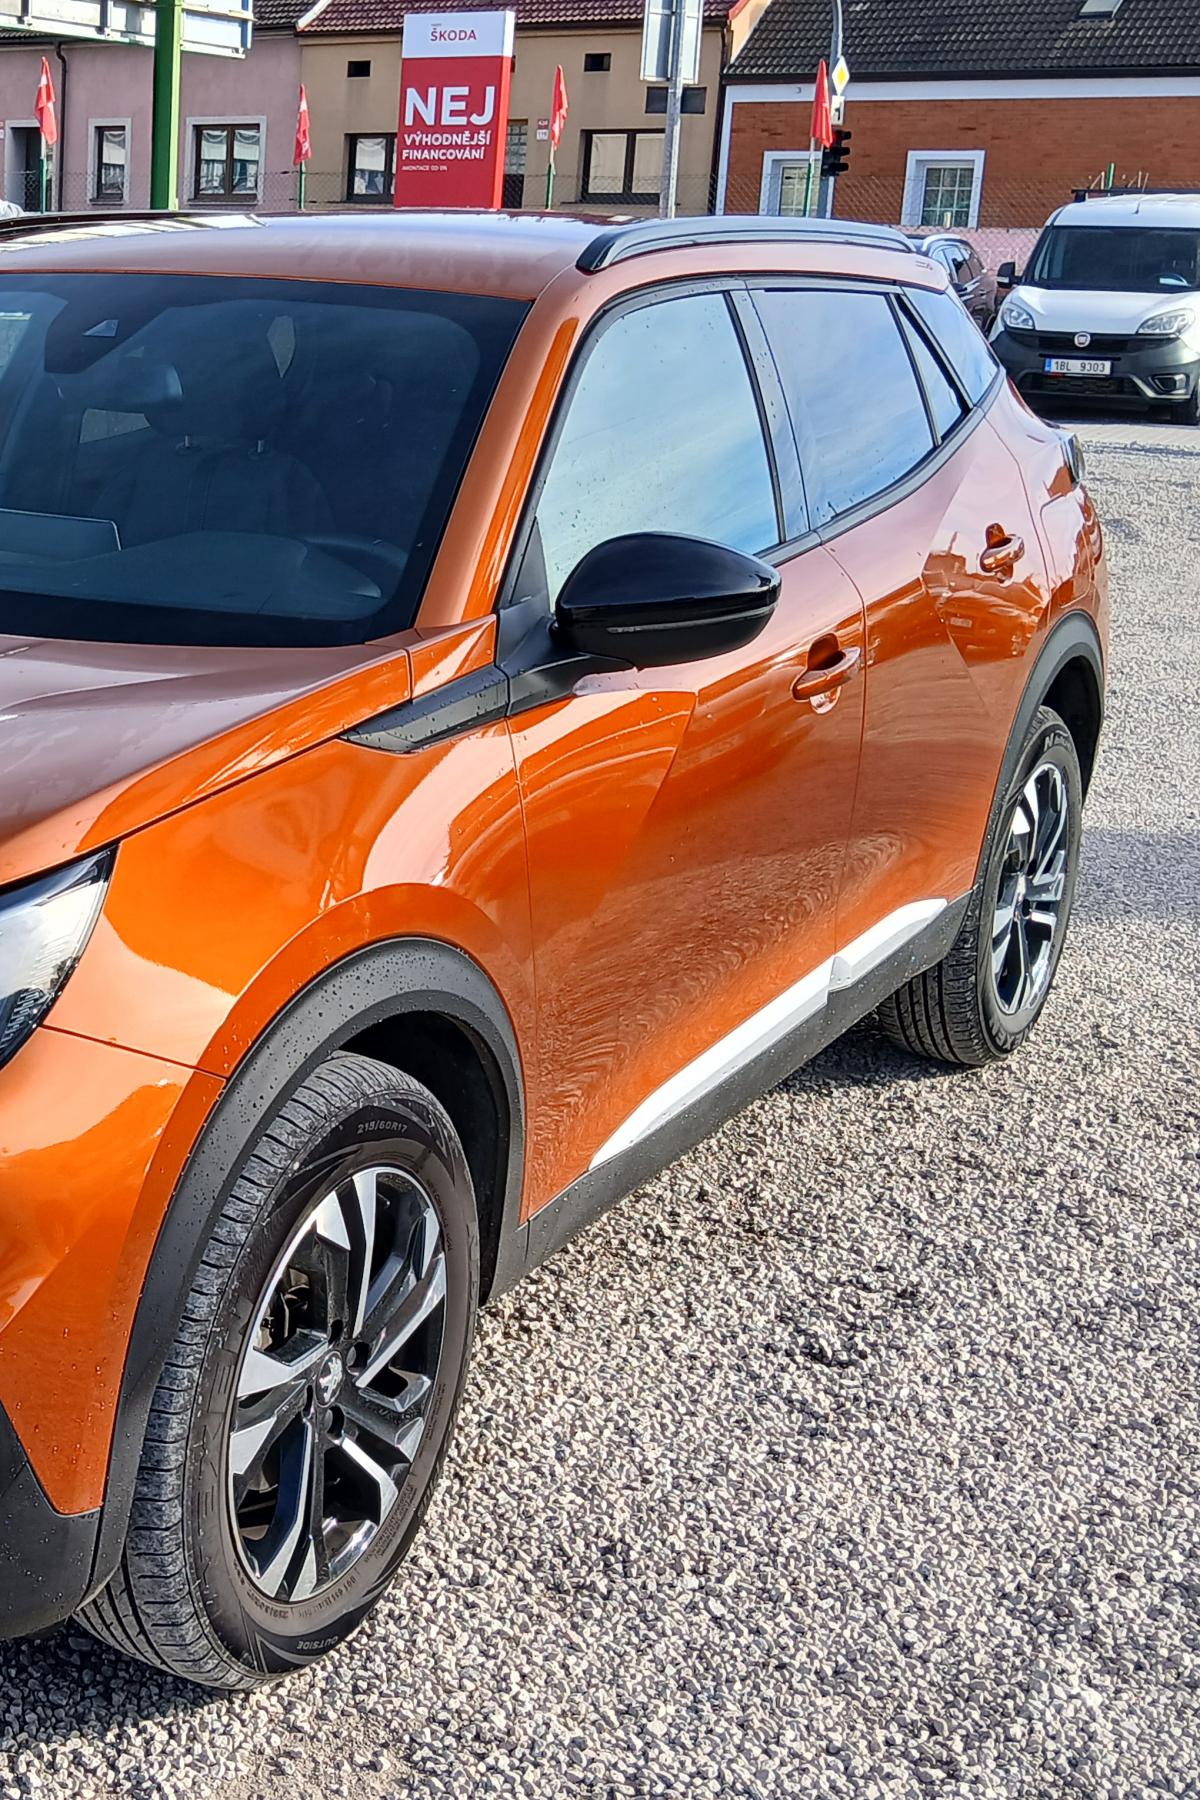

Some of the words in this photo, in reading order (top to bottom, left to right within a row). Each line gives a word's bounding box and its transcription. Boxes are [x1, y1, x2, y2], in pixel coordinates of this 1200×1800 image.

[430, 27, 477, 42] ŠKODA
[404, 85, 496, 126] NEJ
[403, 129, 492, 146] VÝHODNĚJŠÍ
[402, 147, 485, 160] FINANCOVÁNÍ
[1054, 360, 1072, 371] 1BL
[1080, 362, 1106, 373] 9303
[356, 1120, 408, 1135] 215/60R17
[296, 1635, 339, 1651] OUTSIDE
